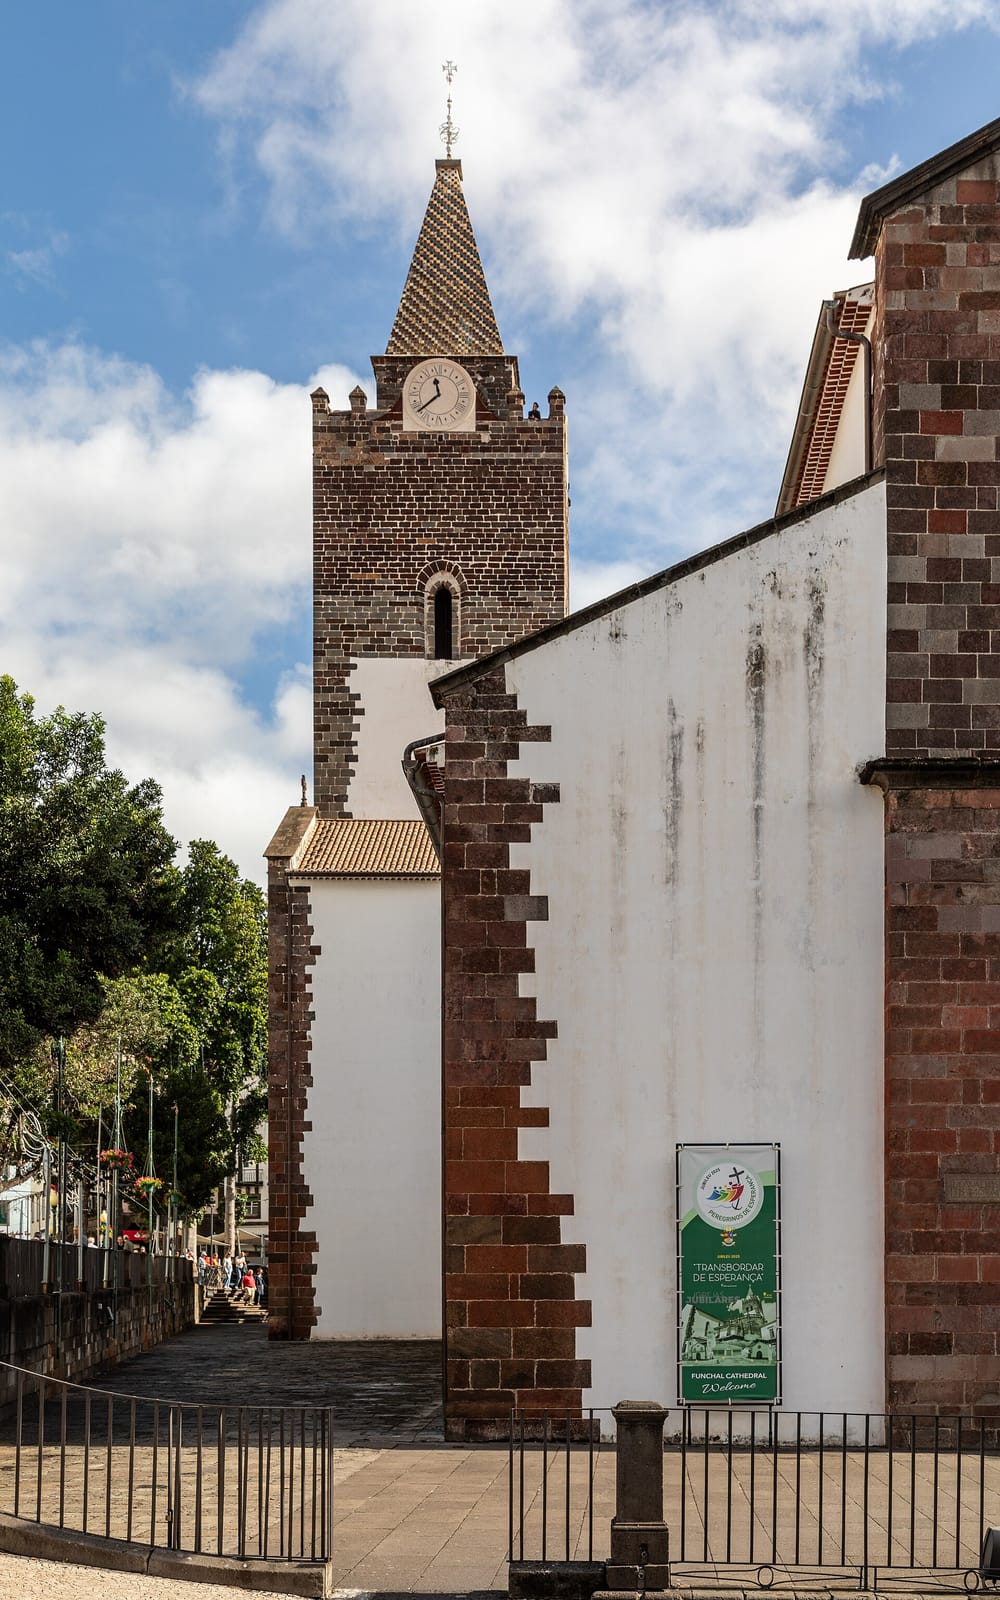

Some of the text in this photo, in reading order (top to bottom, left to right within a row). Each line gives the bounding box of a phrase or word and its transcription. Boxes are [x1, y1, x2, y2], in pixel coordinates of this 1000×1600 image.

[708, 1175, 757, 1222] PEREGRINOS DE ESPERANÇA
[693, 1273, 706, 1282] DE
[702, 1381, 757, 1394] Welcome
